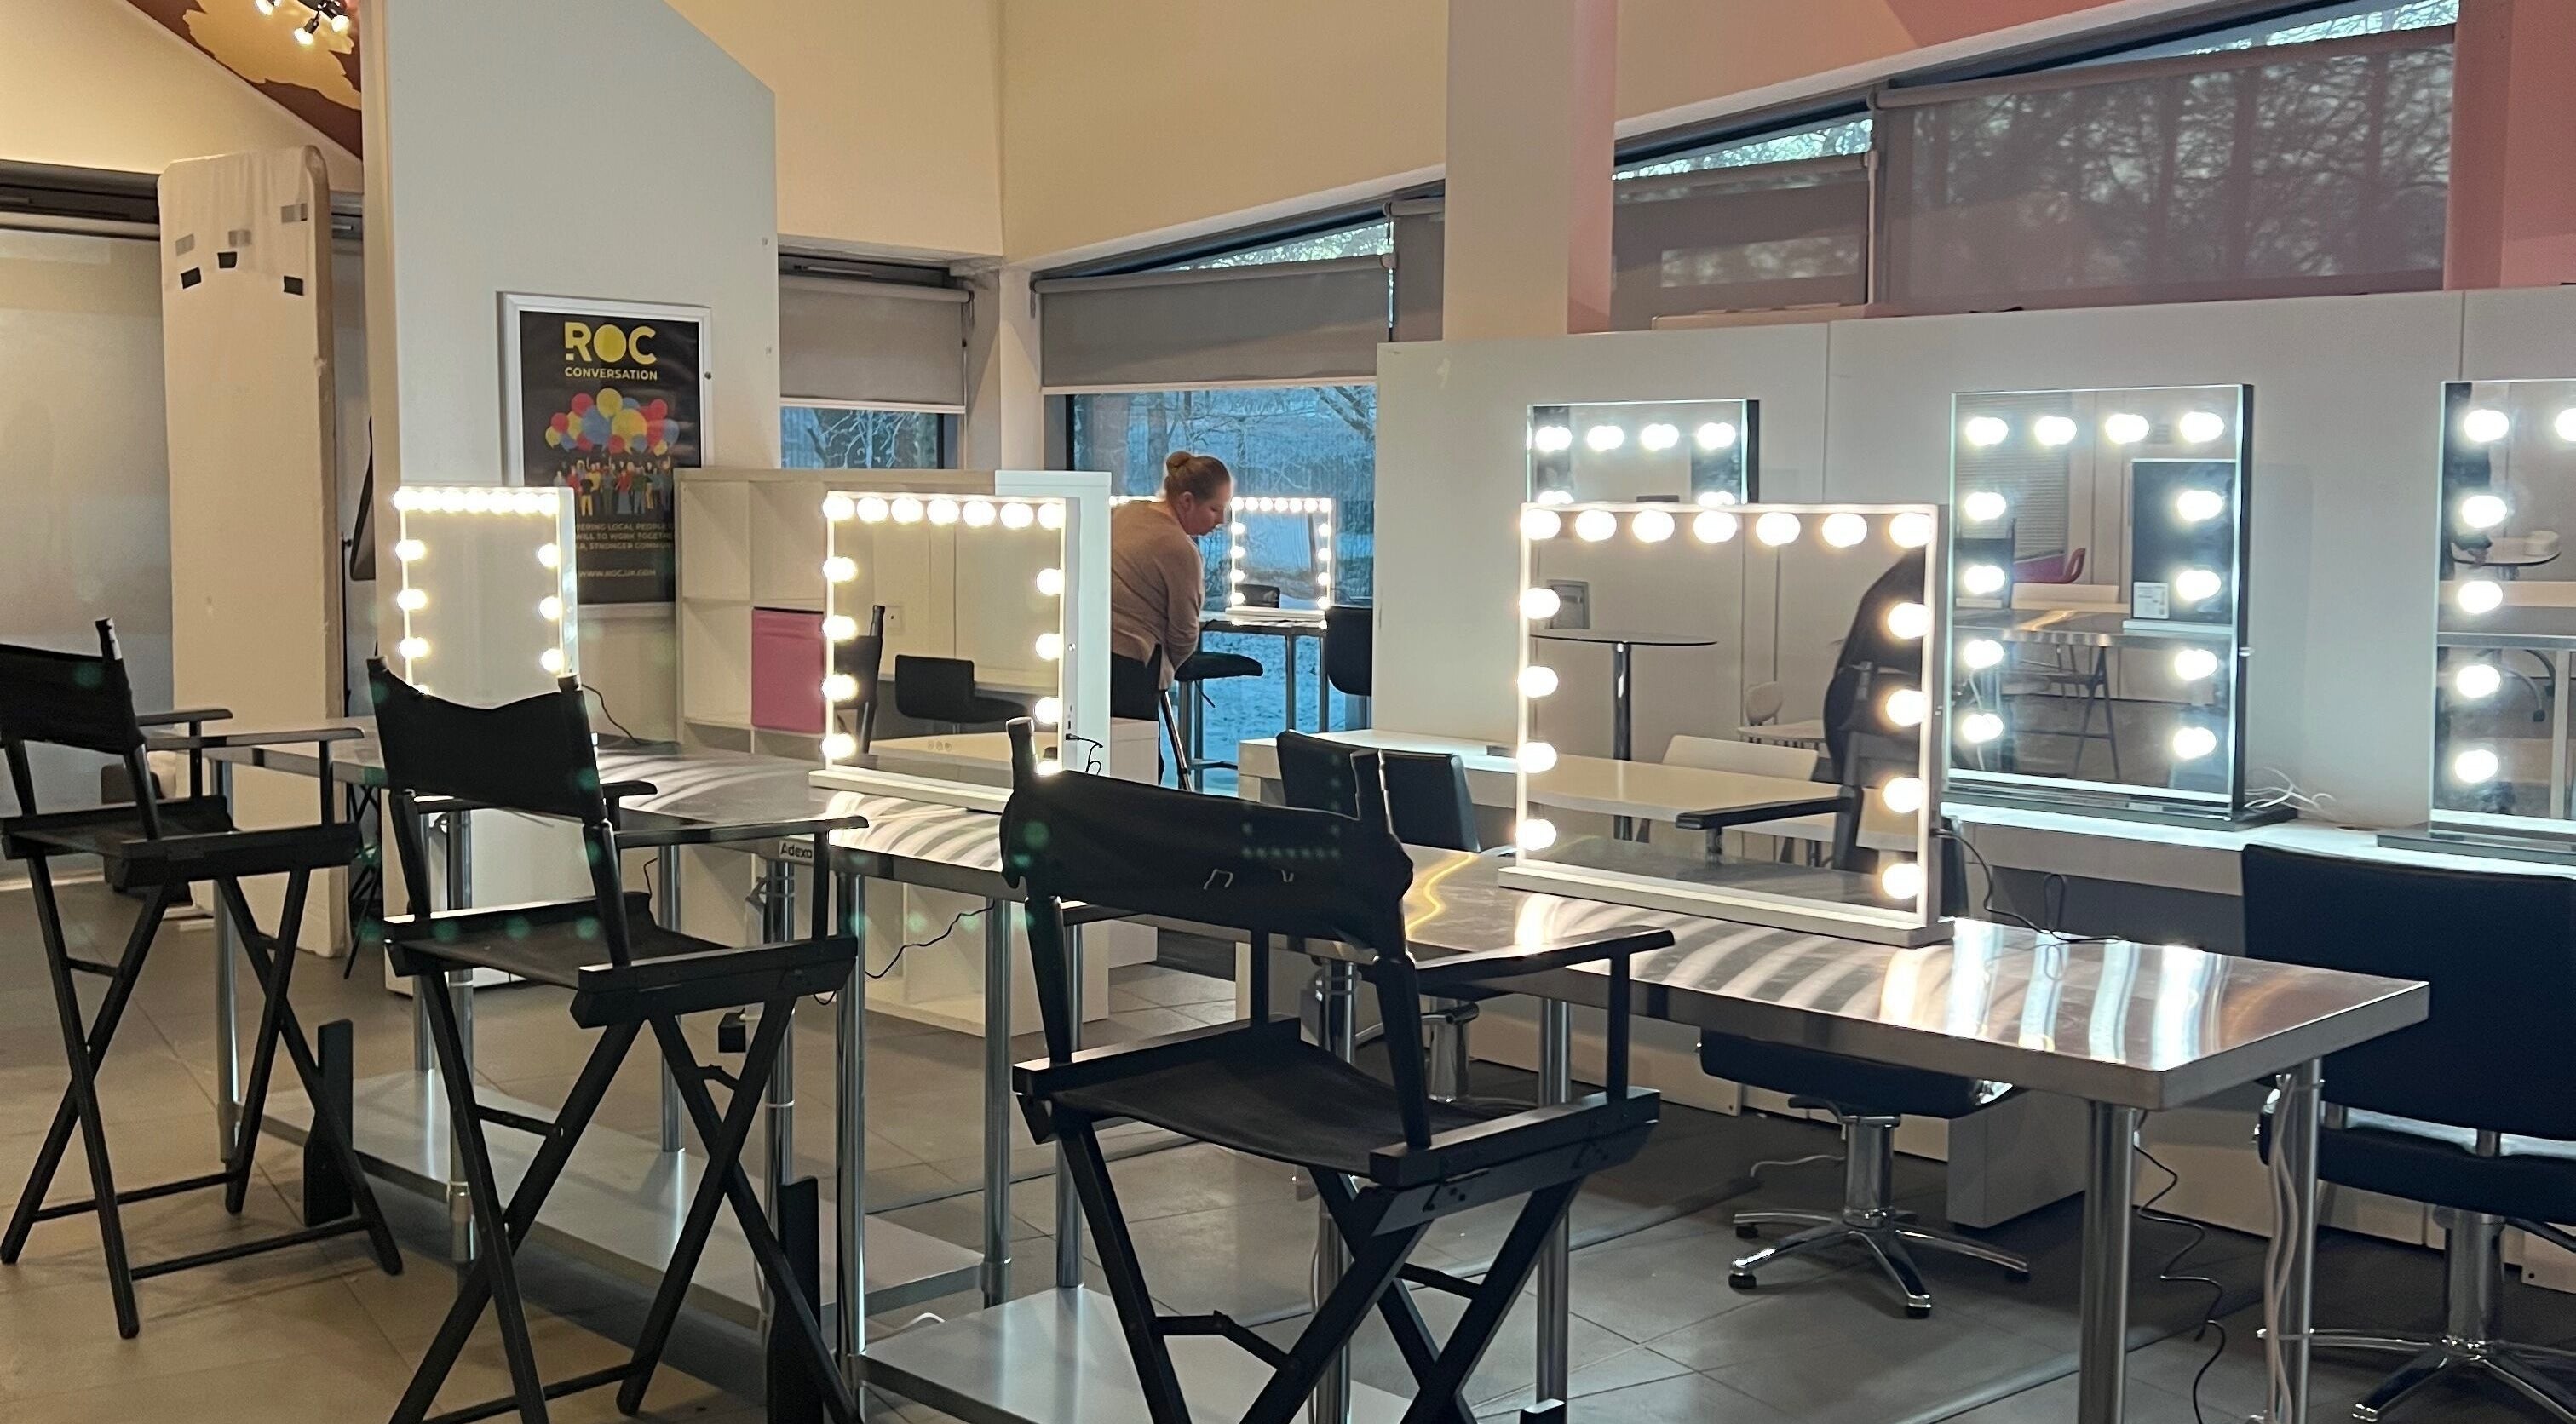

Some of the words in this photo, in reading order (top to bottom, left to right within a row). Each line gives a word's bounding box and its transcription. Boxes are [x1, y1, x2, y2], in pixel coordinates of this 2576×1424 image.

[564, 321, 657, 365] ROC
[564, 366, 658, 381] CONVERSATION
[589, 542, 633, 550] STRONGER
